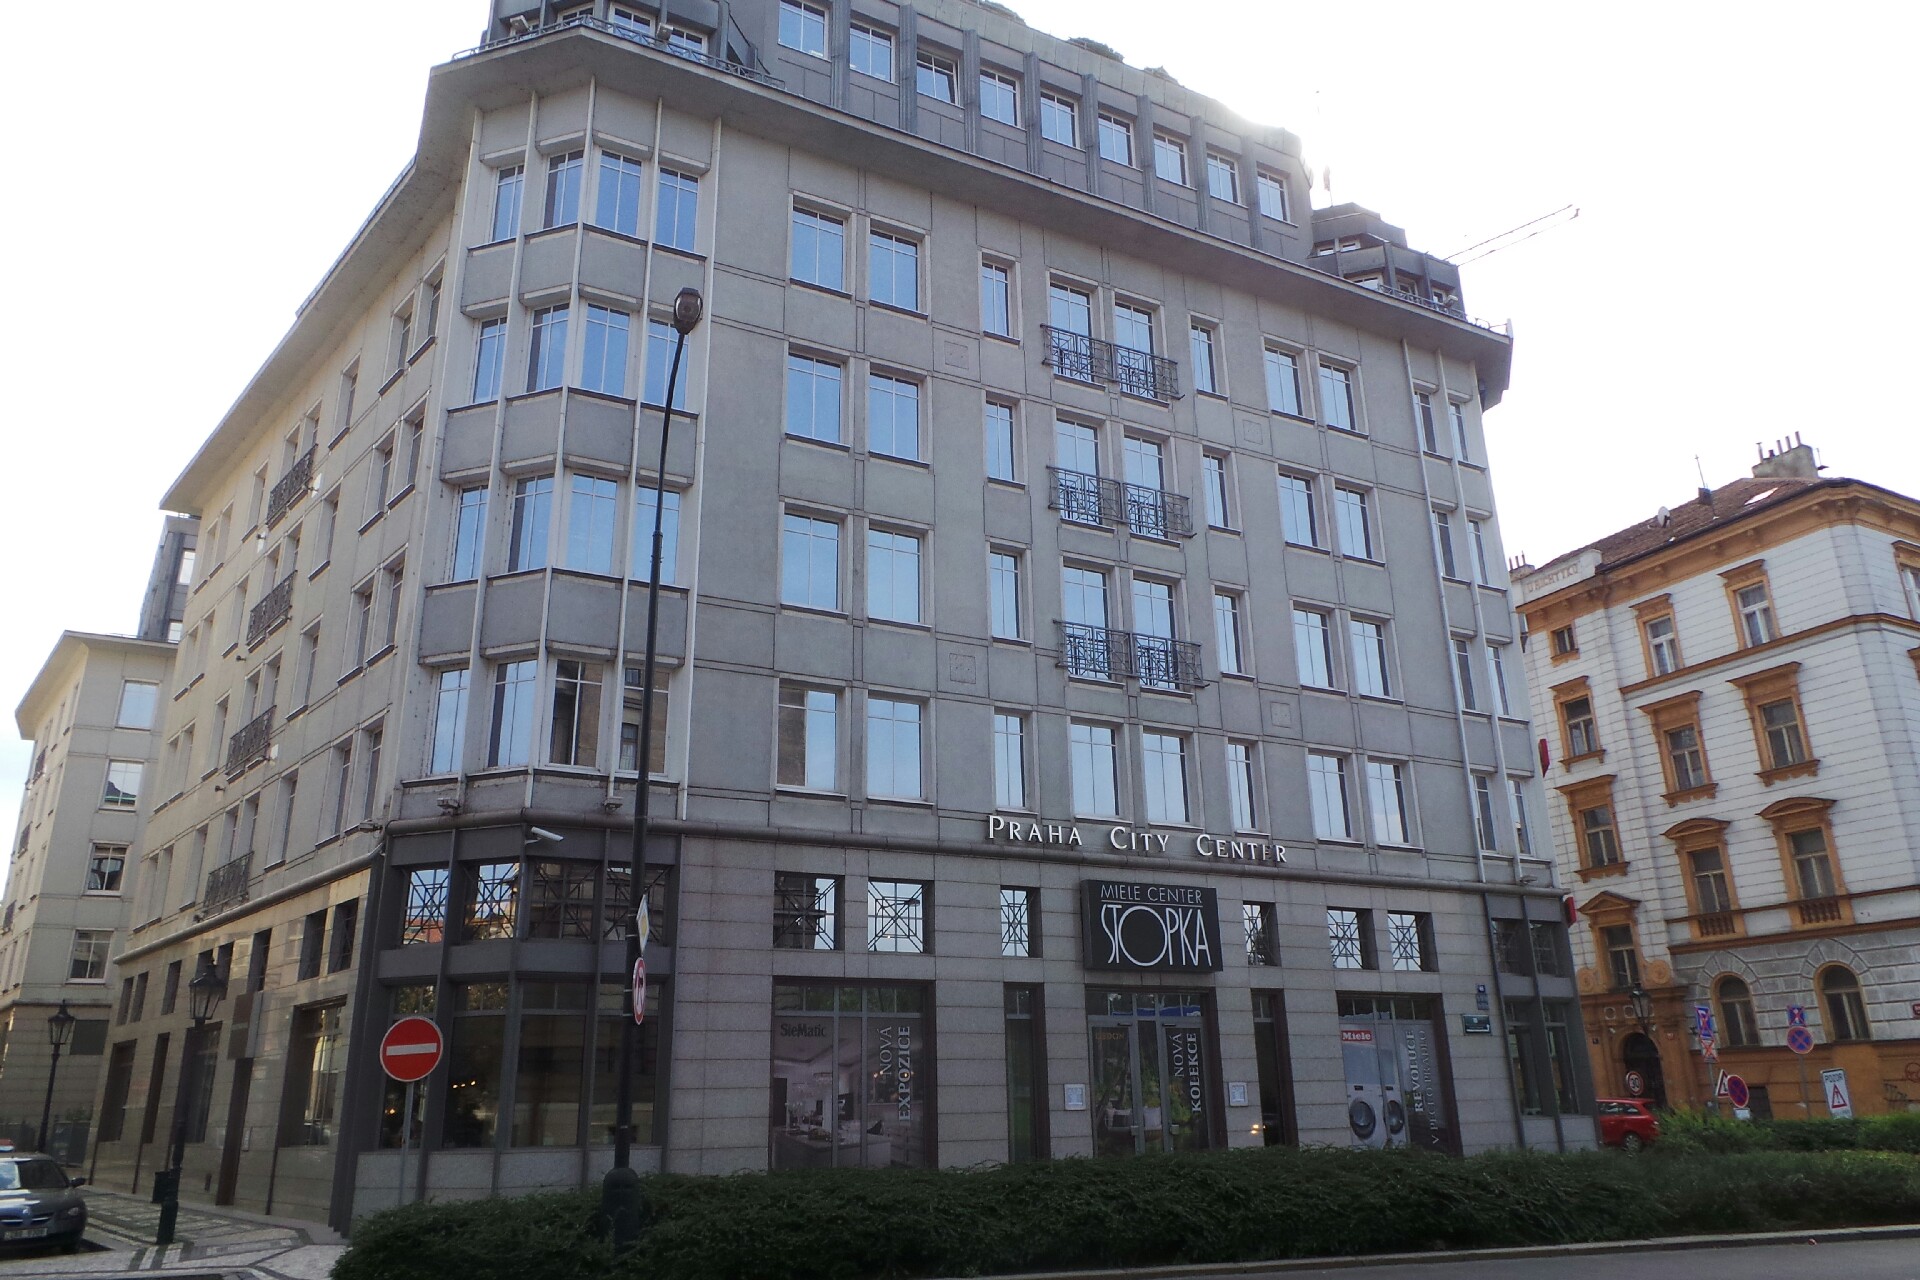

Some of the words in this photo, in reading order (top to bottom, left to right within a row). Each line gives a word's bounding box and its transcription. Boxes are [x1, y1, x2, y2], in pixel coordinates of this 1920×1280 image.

[987, 815, 1083, 846] PRAHA
[1110, 826, 1169, 852] CITY
[1196, 834, 1287, 863] CENTER
[1101, 884, 1140, 900] MIELE
[1147, 886, 1202, 904] CENTER
[1101, 903, 1212, 967] STOPKA
[780, 1023, 826, 1038] SieMatic
[877, 1026, 892, 1075] NOVÁ
[1342, 1031, 1371, 1041] Miele
[898, 1026, 911, 1122] EXPOZICE
[1169, 1033, 1185, 1077] NOVÁ
[1186, 1033, 1201, 1114] KOLEKCE
[1406, 1030, 1424, 1112] REVOLUCE
